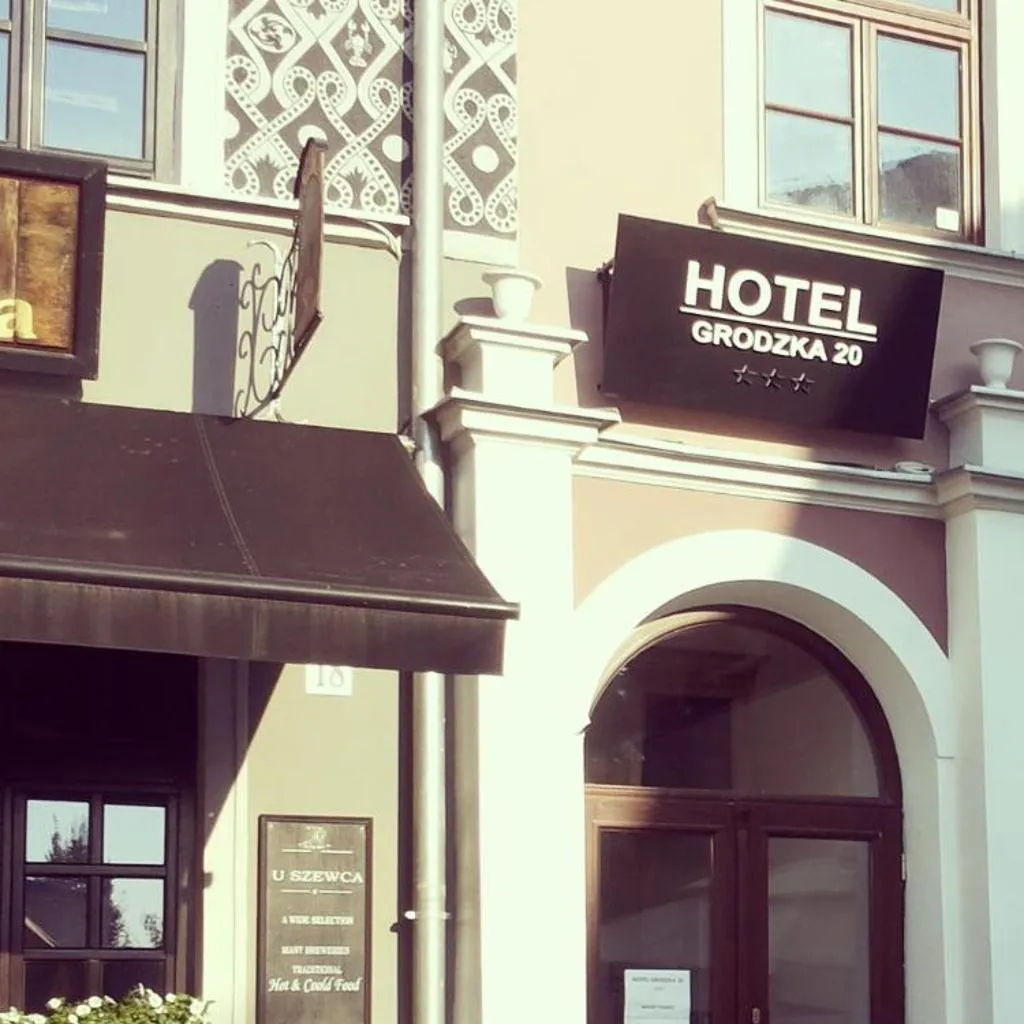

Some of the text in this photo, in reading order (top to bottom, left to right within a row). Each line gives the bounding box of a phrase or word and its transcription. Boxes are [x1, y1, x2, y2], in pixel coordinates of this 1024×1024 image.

[684, 260, 877, 335] HOTEL
[691, 320, 863, 366] GRODZKA 20
[316, 664, 345, 688] 18
[272, 869, 364, 884] U SZEWCA
[267, 976, 290, 992] Hot
[290, 978, 300, 992] &
[333, 976, 363, 992] Food
